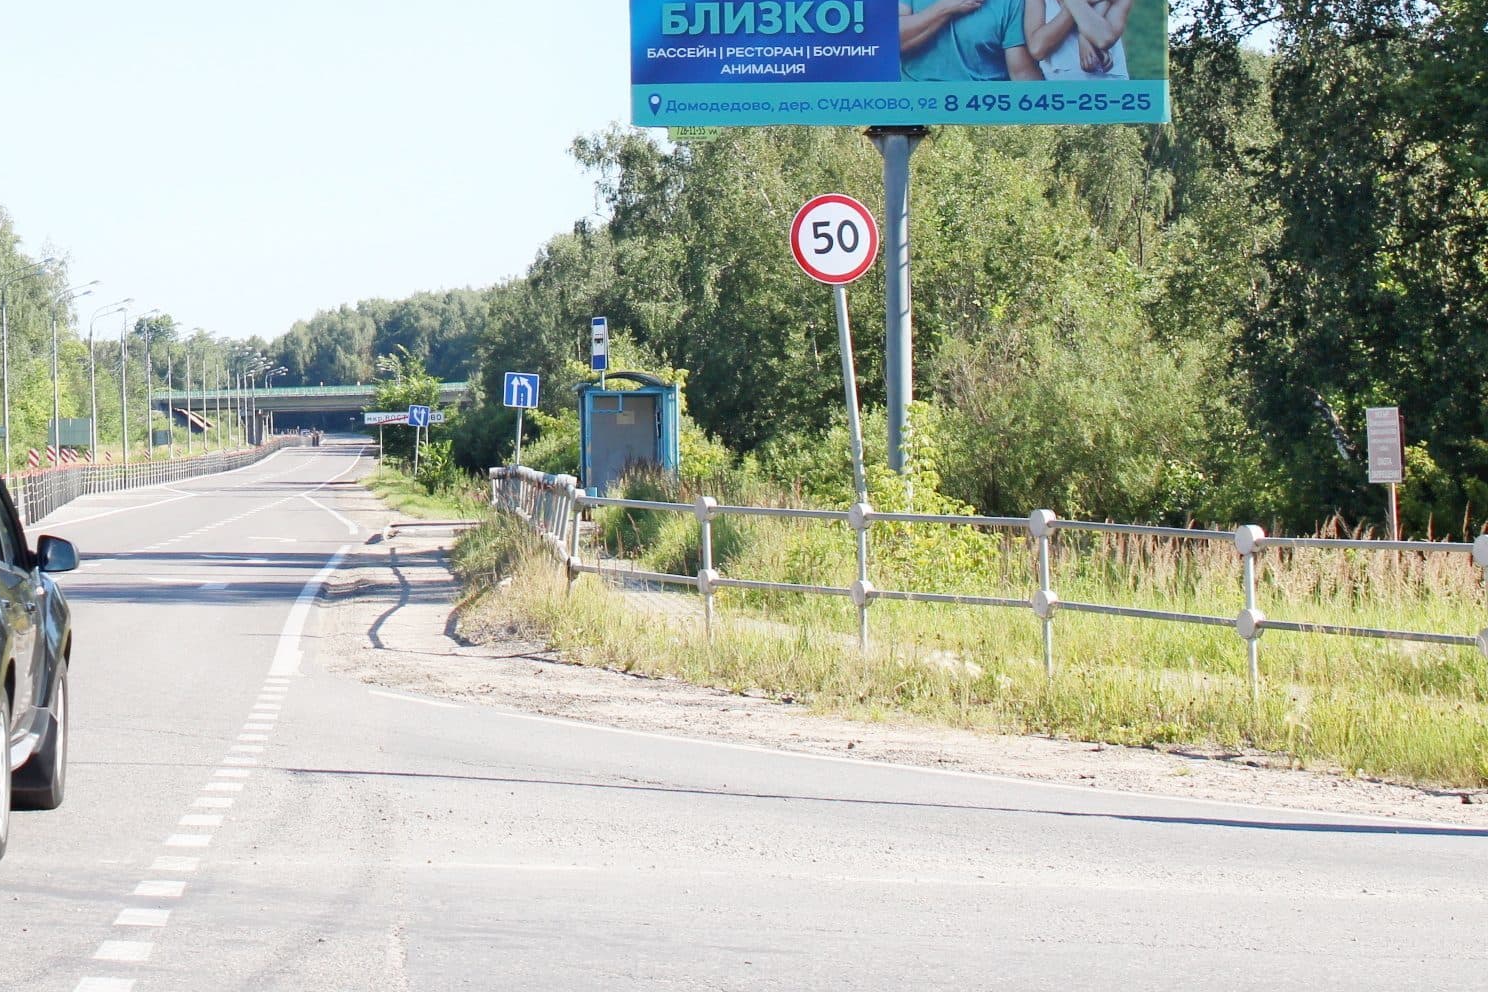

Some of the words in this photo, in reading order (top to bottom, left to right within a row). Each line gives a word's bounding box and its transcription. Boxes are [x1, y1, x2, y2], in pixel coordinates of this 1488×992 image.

[661, 0, 865, 35] БЛИЗКО!
[647, 45, 717, 58] БАССЕЙН
[726, 46, 804, 58] РЕСТОРАН
[813, 45, 880, 57] БОУЛИНГ
[720, 63, 806, 75] АНИМАЦИЯ
[665, 99, 774, 114] Домодедово,
[778, 100, 814, 114] дер.
[918, 97, 938, 109] 92
[944, 94, 959, 111] 8
[966, 94, 1012, 111] 495
[1018, 93, 1152, 111] 645-25-25
[812, 219, 860, 255] 50
